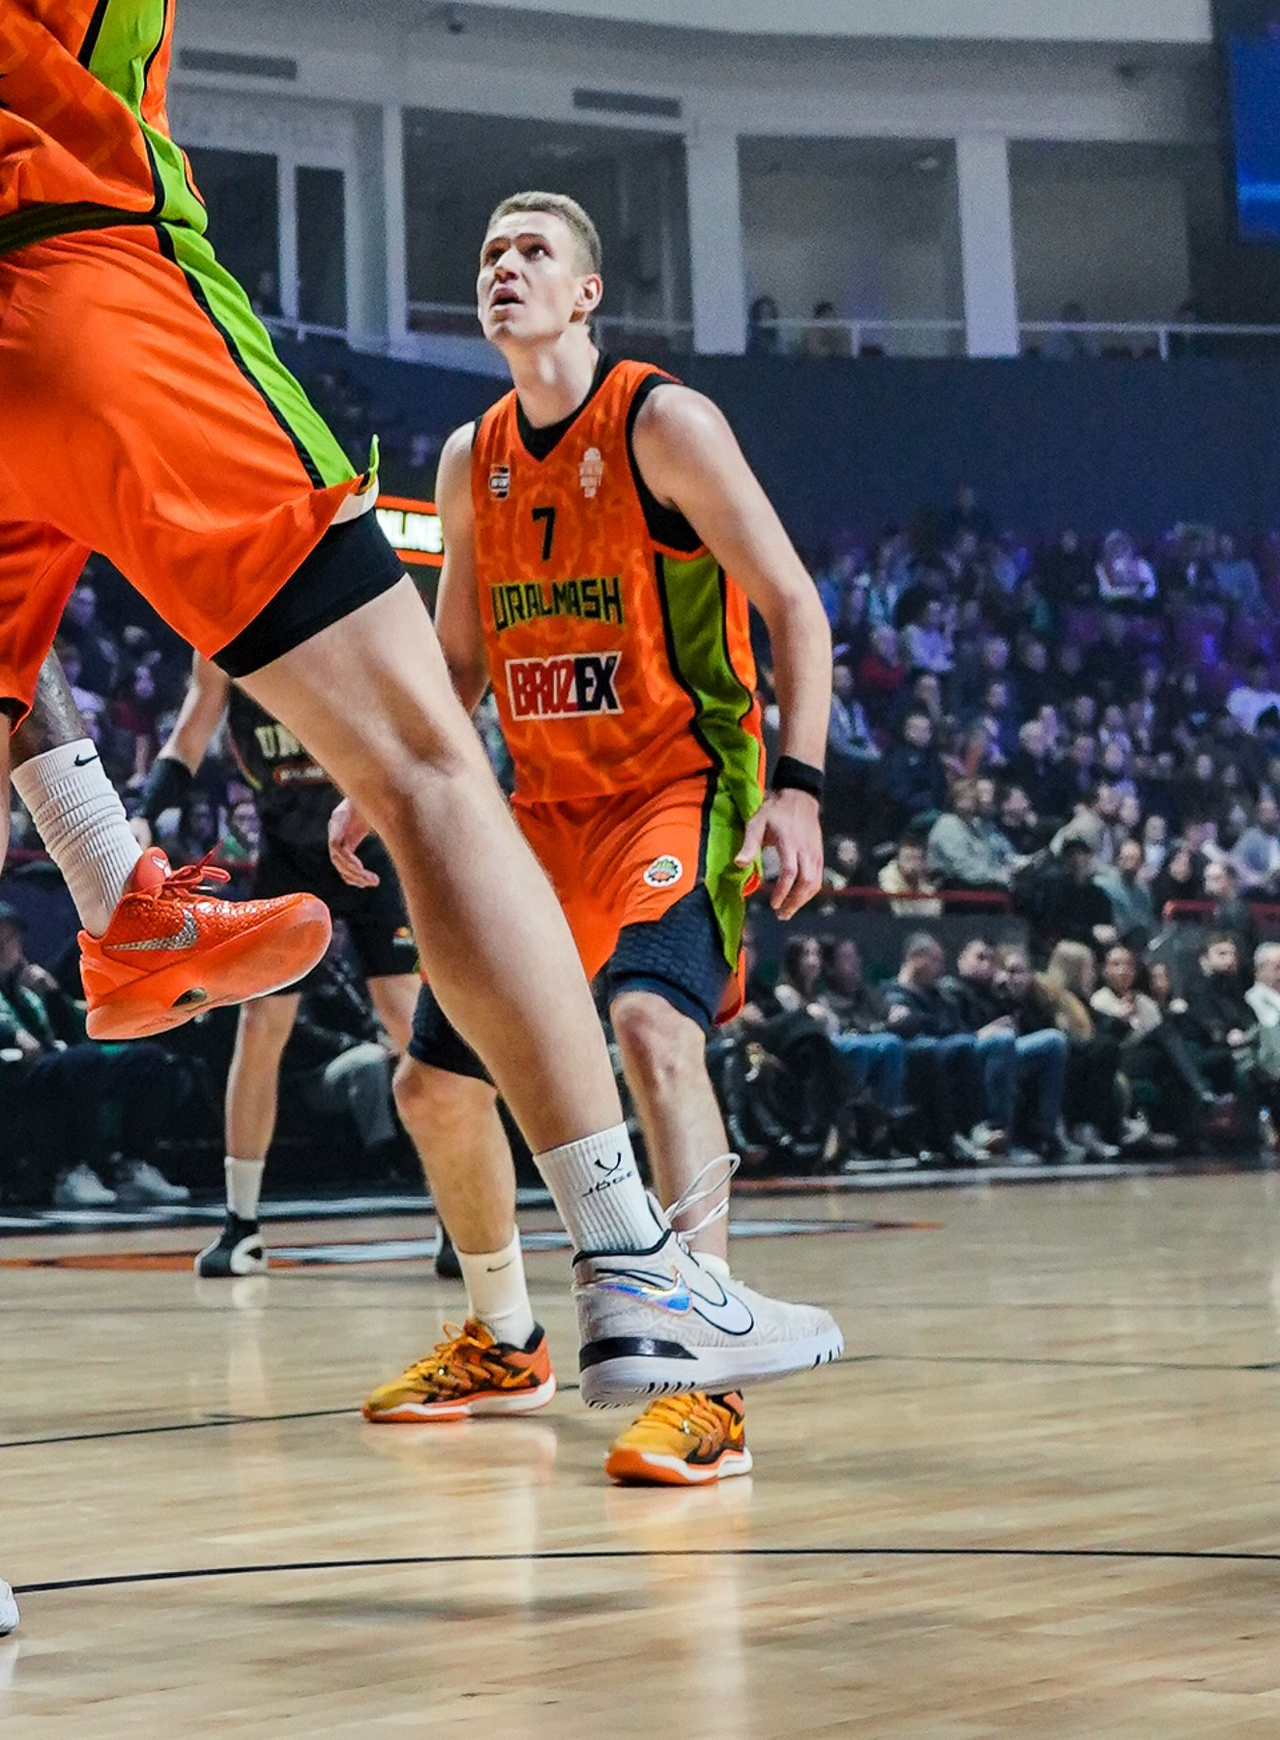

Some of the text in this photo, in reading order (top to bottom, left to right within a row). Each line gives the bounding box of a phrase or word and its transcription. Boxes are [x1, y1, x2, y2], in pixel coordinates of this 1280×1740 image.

[531, 506, 557, 562] 7
[489, 575, 625, 634] URALMASH
[508, 656, 620, 717] BROZEX
